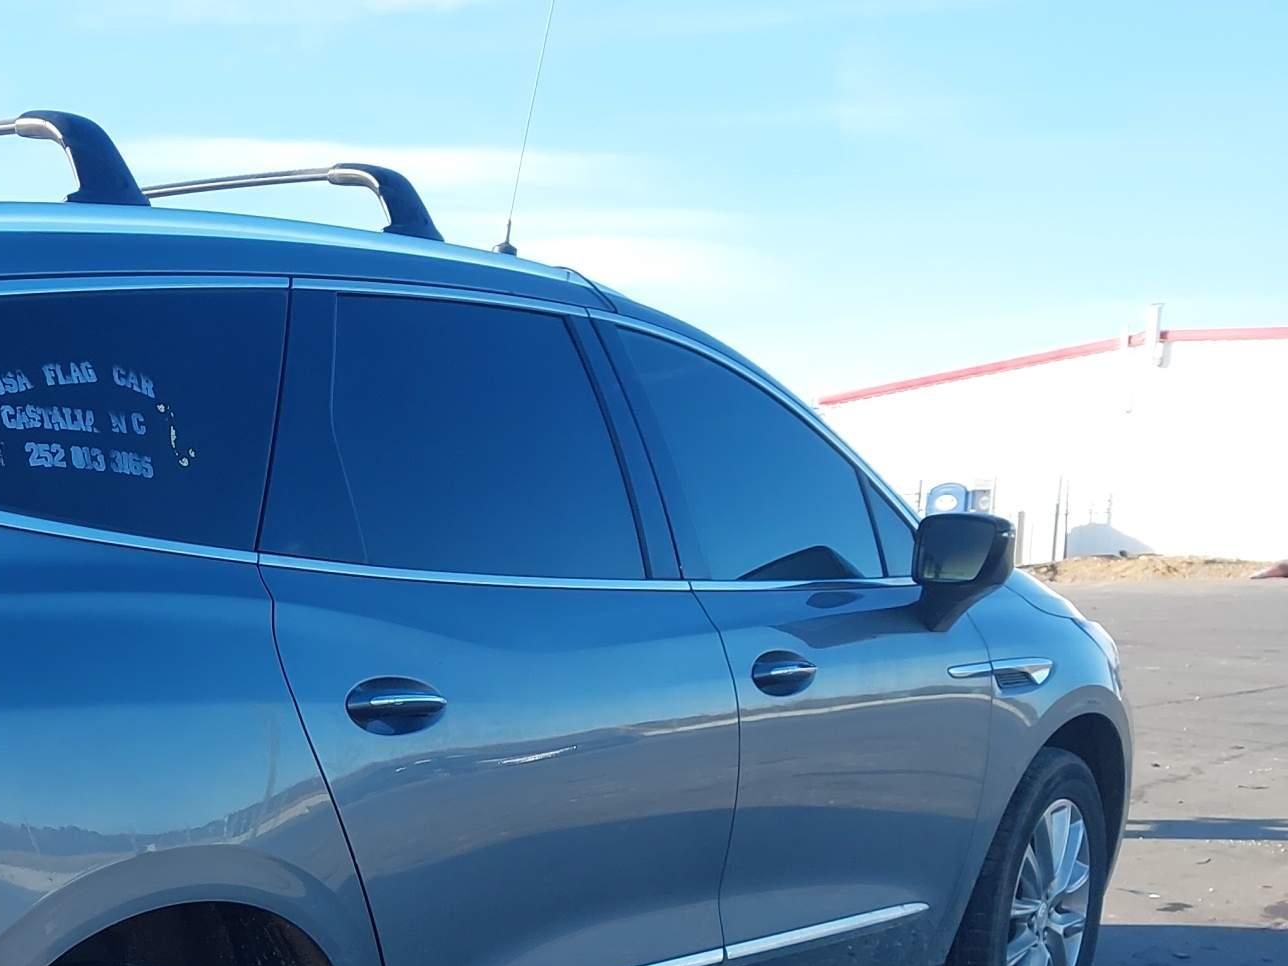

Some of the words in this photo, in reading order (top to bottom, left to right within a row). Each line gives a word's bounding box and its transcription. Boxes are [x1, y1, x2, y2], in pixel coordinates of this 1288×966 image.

[42, 361, 98, 386] FLAG
[112, 366, 155, 398] CAR
[0, 404, 101, 432] CASTALIA
[24, 442, 66, 468] 252
